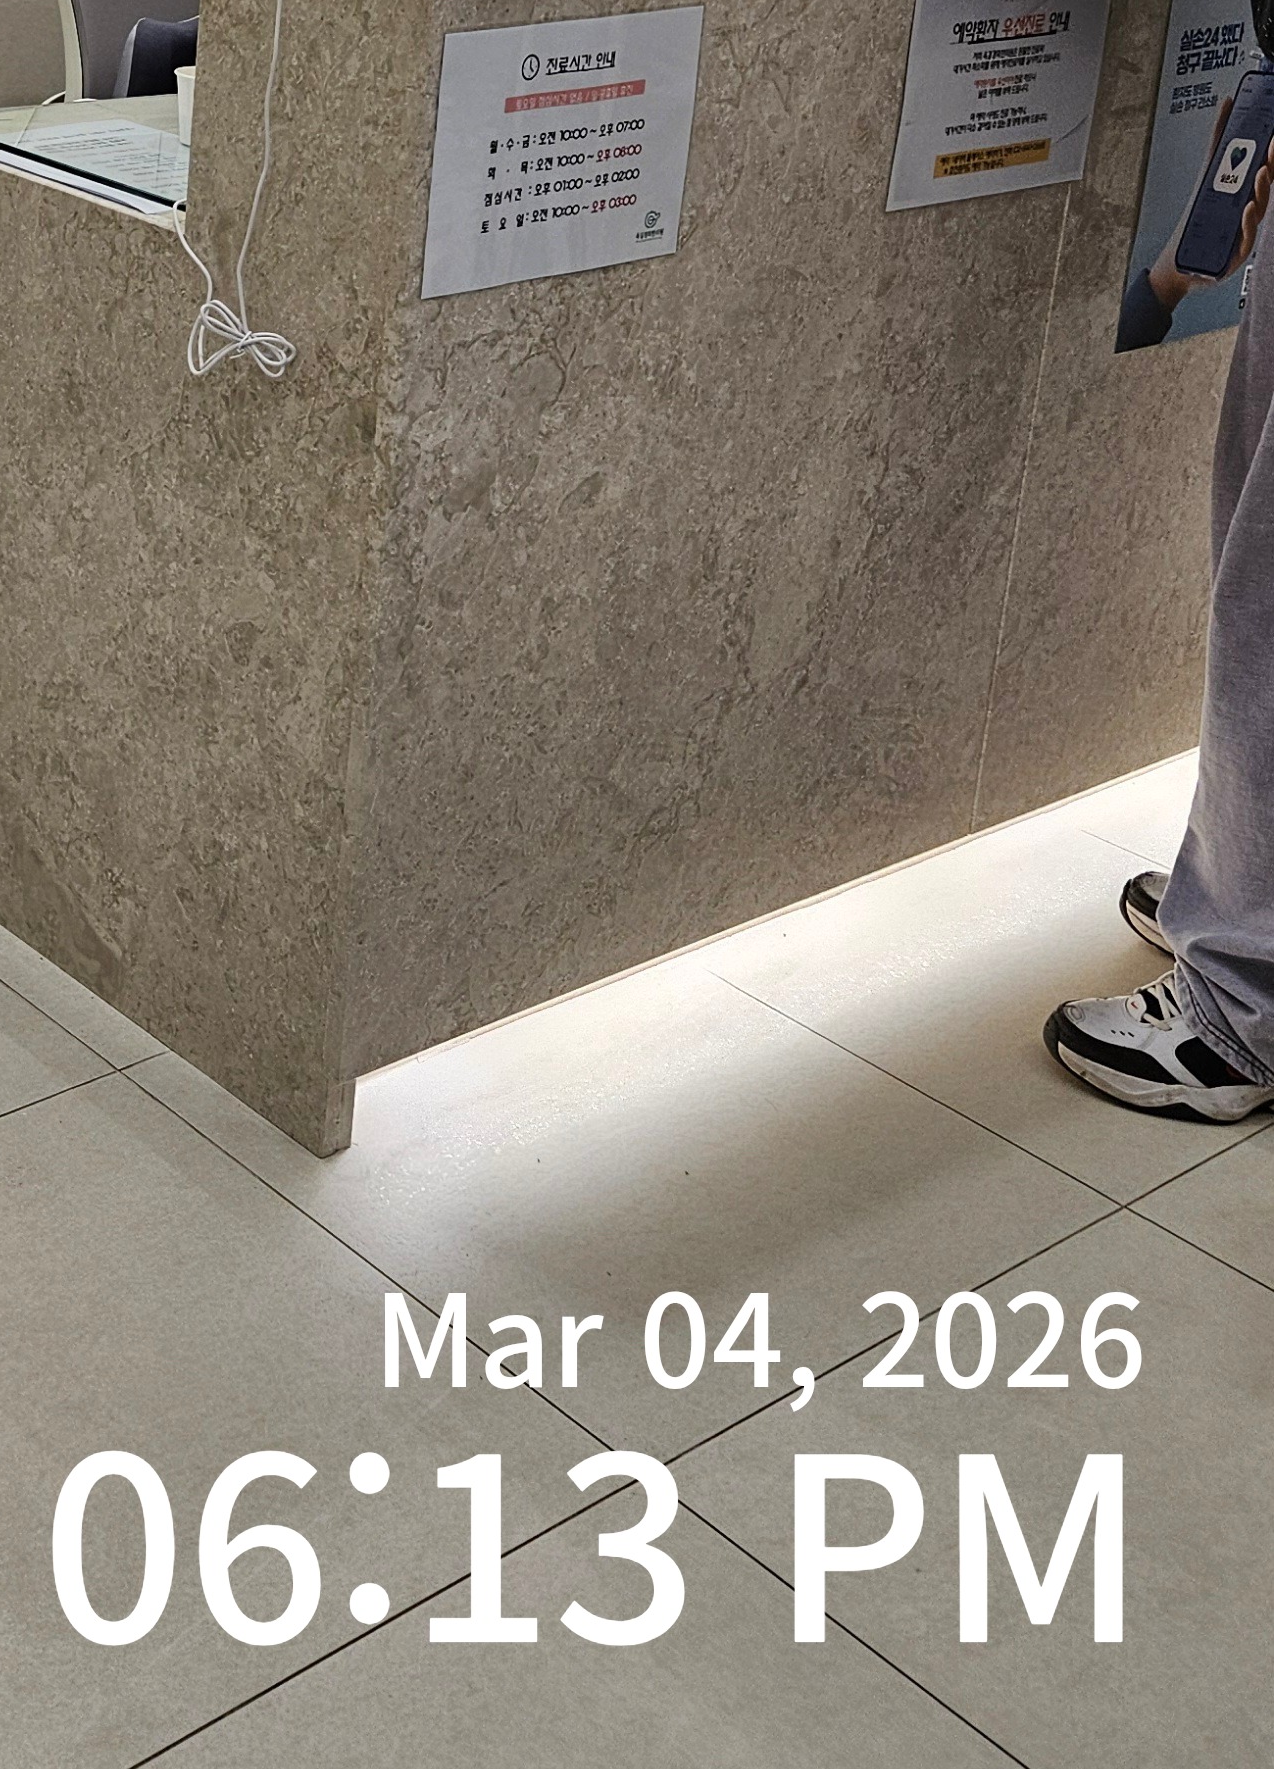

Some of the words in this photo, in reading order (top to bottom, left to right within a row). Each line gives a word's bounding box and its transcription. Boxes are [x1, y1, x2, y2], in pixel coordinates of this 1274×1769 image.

[953, 18, 1000, 43] 예약환자
[1049, 10, 1071, 32] 안내
[1180, 26, 1220, 52] 실손24
[546, 54, 592, 74] 진료시간
[595, 51, 616, 68] 안내
[1176, 51, 1201, 75] 청구
[538, 131, 556, 146] 오전
[560, 127, 588, 142] 10:00
[598, 123, 614, 137] 오후
[615, 118, 645, 133] 07:00
[535, 157, 553, 172] 오전
[557, 153, 585, 167] 10:00
[596, 148, 611, 163] 오후
[483, 187, 523, 207] 점심시간
[534, 182, 551, 196] 오후
[553, 178, 584, 192] 01:00
[593, 173, 609, 188] 오후
[611, 168, 641, 182] 02:00
[480, 220, 490, 234] 토
[498, 216, 507, 230] 요
[531, 208, 549, 223] 오전
[552, 204, 581, 218] 10:00
[590, 199, 606, 214] 오후
[608, 194, 637, 209] 03:00
